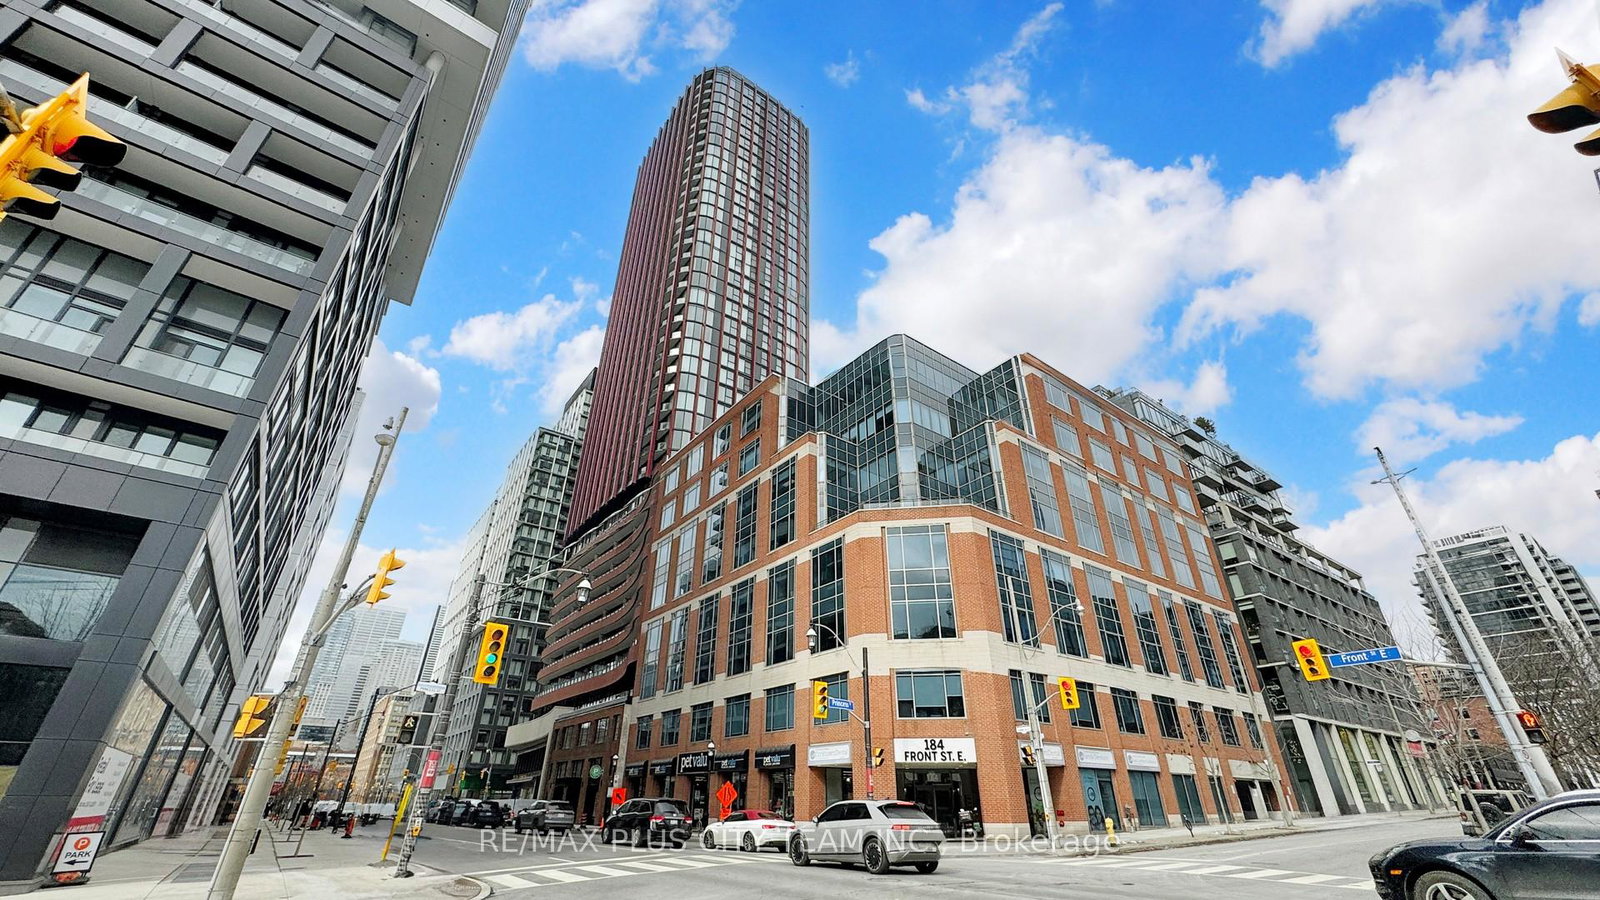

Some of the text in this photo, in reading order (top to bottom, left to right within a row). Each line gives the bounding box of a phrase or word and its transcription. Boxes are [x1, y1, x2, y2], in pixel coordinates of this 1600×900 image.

[1341, 653, 1368, 663] Front
[1380, 649, 1388, 658] E
[924, 739, 945, 750] 184
[904, 751, 967, 761] FRONT ST. E.
[65, 851, 92, 859] PARK
